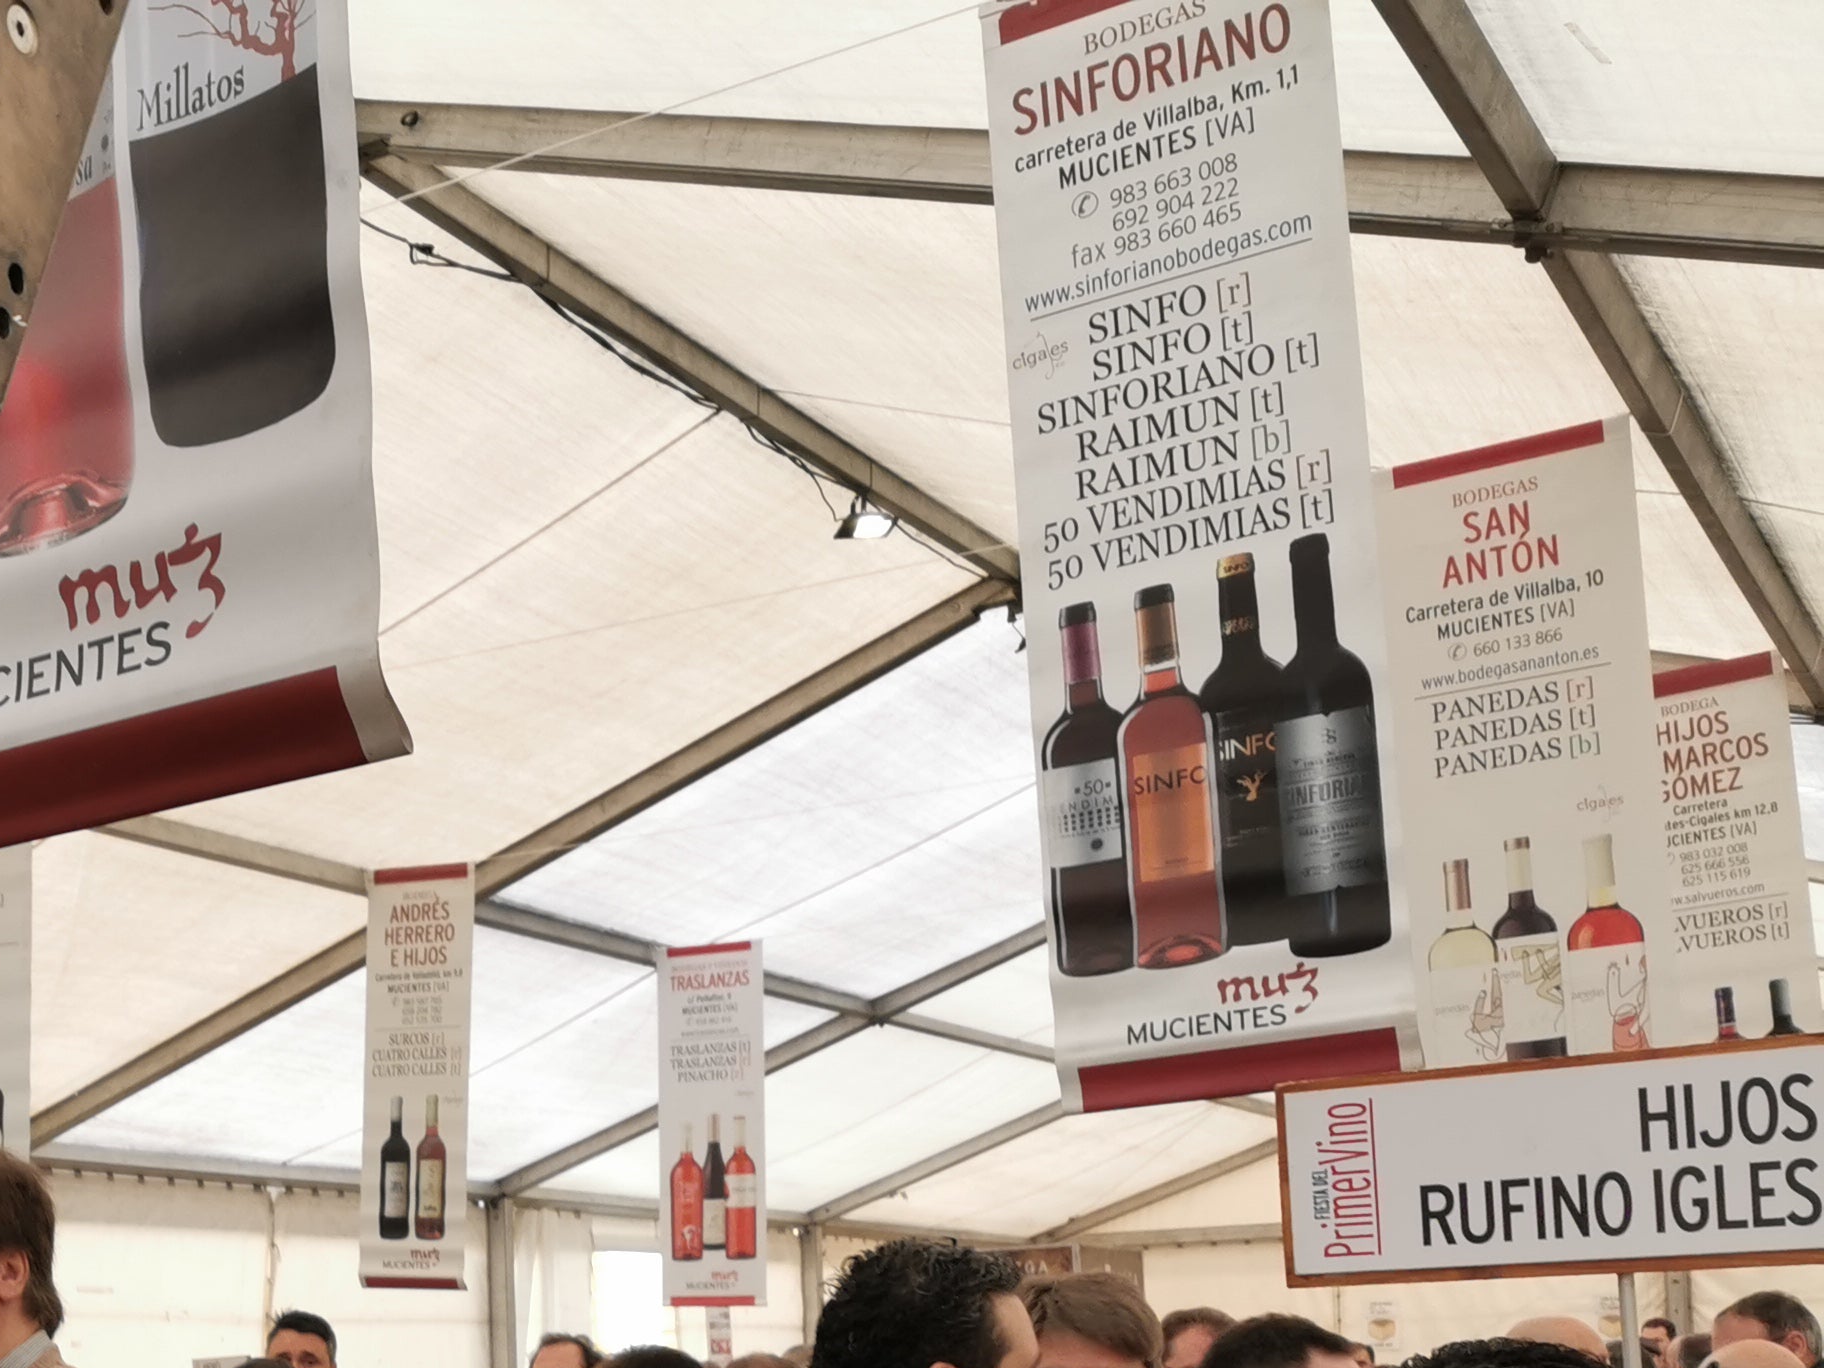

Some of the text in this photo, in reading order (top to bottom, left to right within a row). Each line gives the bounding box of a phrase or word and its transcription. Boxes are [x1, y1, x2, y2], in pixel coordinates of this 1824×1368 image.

[1083, 0, 1207, 55] BODEGAS
[1012, 3, 1291, 136] SINFORIANO
[136, 62, 245, 131] Millatos
[1014, 64, 1300, 173] carretera de Villalba, Km. 1,1
[1059, 107, 1256, 190] MUCIENTES [VA]
[1110, 152, 1238, 209] 983 663 008
[1112, 177, 1239, 232] 692 904 222
[1071, 201, 1242, 269] fax 983 660 465
[1024, 213, 1313, 313] www.sinforianobodegas.com
[1088, 271, 1252, 345] SINFO [r]
[1092, 310, 1254, 383] SINFO [t]
[1037, 332, 1320, 435] SINFORIANO [t]
[1075, 381, 1285, 463] RAIMUN [t]
[1075, 419, 1292, 502] RAIMUN [b]
[1044, 448, 1332, 554] 50 VENDIMIAS [r]
[1452, 477, 1538, 508] BODEGAS
[1048, 489, 1335, 592] 50 VENDIMIAS [t]
[1463, 501, 1531, 544] SAN
[1442, 530, 1559, 588] ANTÓN
[1405, 569, 1604, 624] Carretera de Villalba, 10
[1437, 598, 1575, 641] MUCIENTES [VA]
[1473, 627, 1563, 657] 660 133 866
[1421, 645, 1599, 690] www.bodegasananton.es
[1432, 676, 1594, 723] PANEDAS [r]
[1661, 697, 1719, 717] BODEGA
[1435, 704, 1596, 750] PANEDAS [t]
[1656, 711, 1729, 746] HIJOS
[1435, 732, 1600, 778] PANEDAS [b]
[1663, 733, 1769, 773] MARCOS
[1082, 778, 1104, 797] 50
[1673, 799, 1728, 816] Carretera
[1734, 807, 1751, 819] km
[1680, 842, 1748, 862] 983 032 008
[1681, 855, 1749, 875] 625 666 556
[1682, 867, 1750, 887] 625 115 619
[384, 924, 455, 946] HERRERO
[1674, 901, 1788, 933] VUEROS [r]
[1676, 922, 1790, 953] VUEROS [t]
[390, 946, 448, 967] E HIJOS
[670, 970, 750, 992] TRASLANZAS
[388, 1032, 430, 1046] SURCOS
[1127, 1003, 1287, 1046] MUCIENTES
[1638, 1073, 1818, 1152] HIJOS
[1313, 1190, 1331, 1221] FIESTA
[1419, 1158, 1823, 1247] RUFINO IGLES
